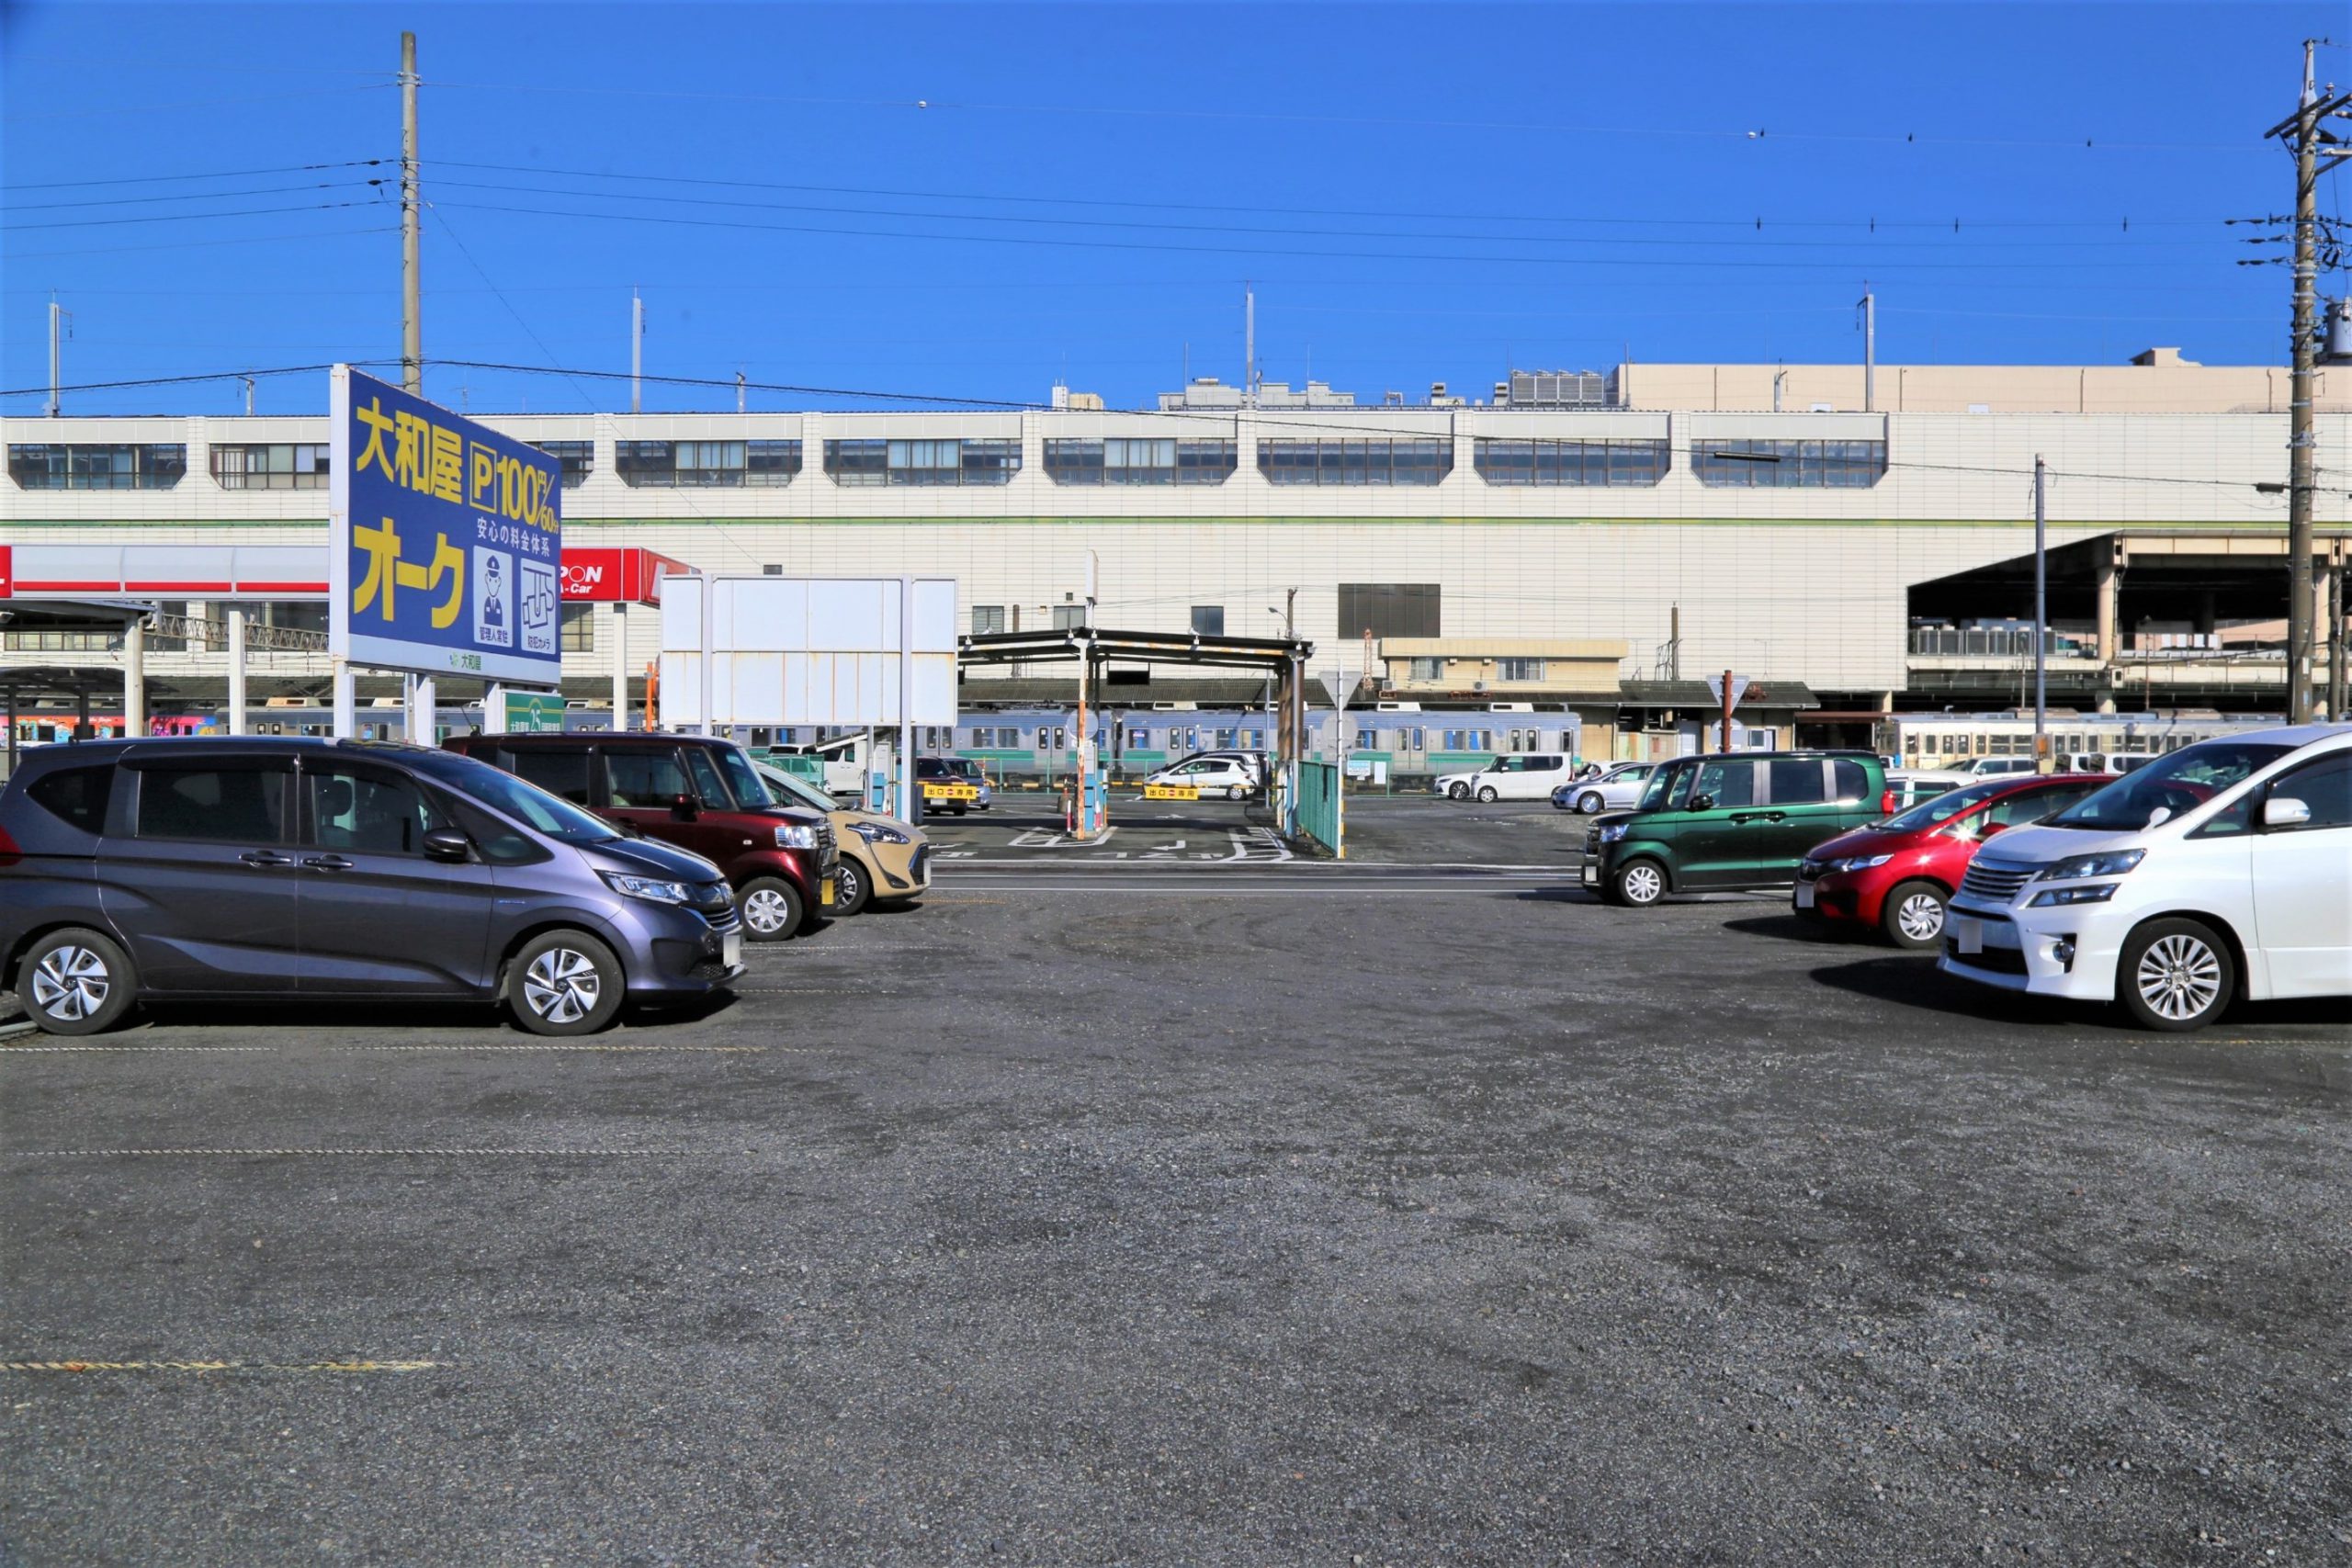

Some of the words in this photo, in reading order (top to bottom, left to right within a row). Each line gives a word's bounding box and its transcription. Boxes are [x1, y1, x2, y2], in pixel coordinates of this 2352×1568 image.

[356, 396, 462, 504] 大和屋
[473, 452, 492, 500] P
[477, 516, 550, 558] 安心の料金体系
[354, 516, 464, 629] オーク
[461, 653, 481, 671] 大和屋
